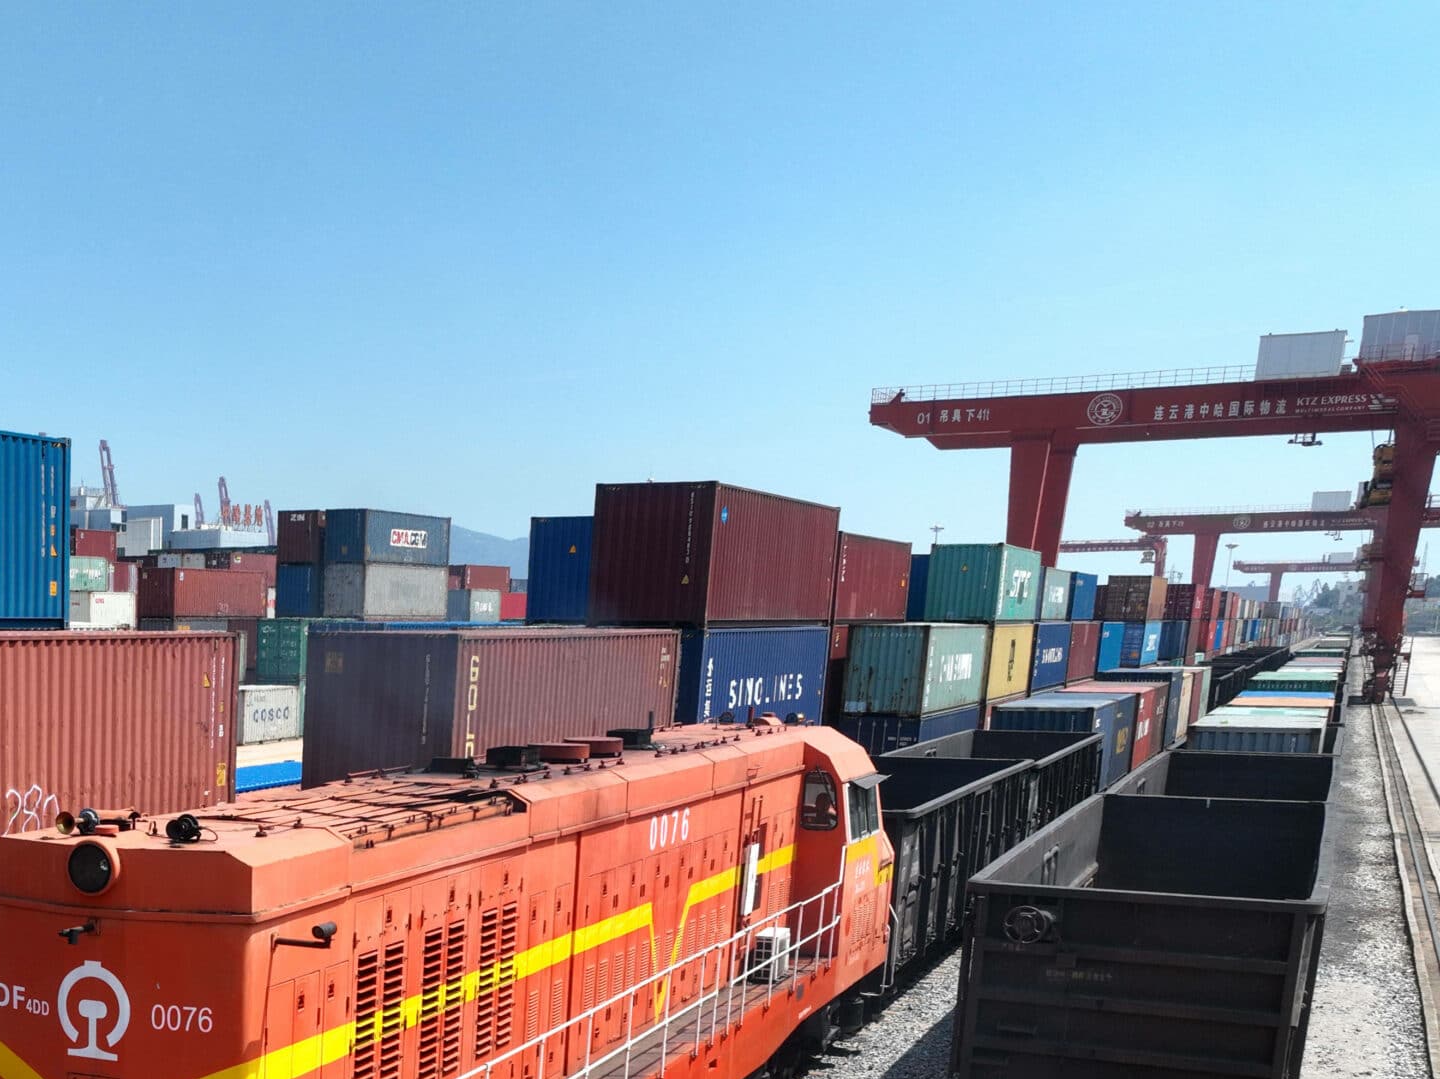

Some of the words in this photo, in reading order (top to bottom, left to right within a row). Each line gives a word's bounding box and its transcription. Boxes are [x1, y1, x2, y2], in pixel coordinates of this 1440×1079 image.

[1153, 399, 1287, 421] 连云港中哈国际物流
[1296, 397, 1318, 407] KTZ
[1321, 394, 1367, 406] EXPRESS
[917, 412, 931, 425] 01
[253, 706, 289, 722] COSCO
[649, 807, 691, 851] 0076
[151, 1003, 213, 1033] 0076
